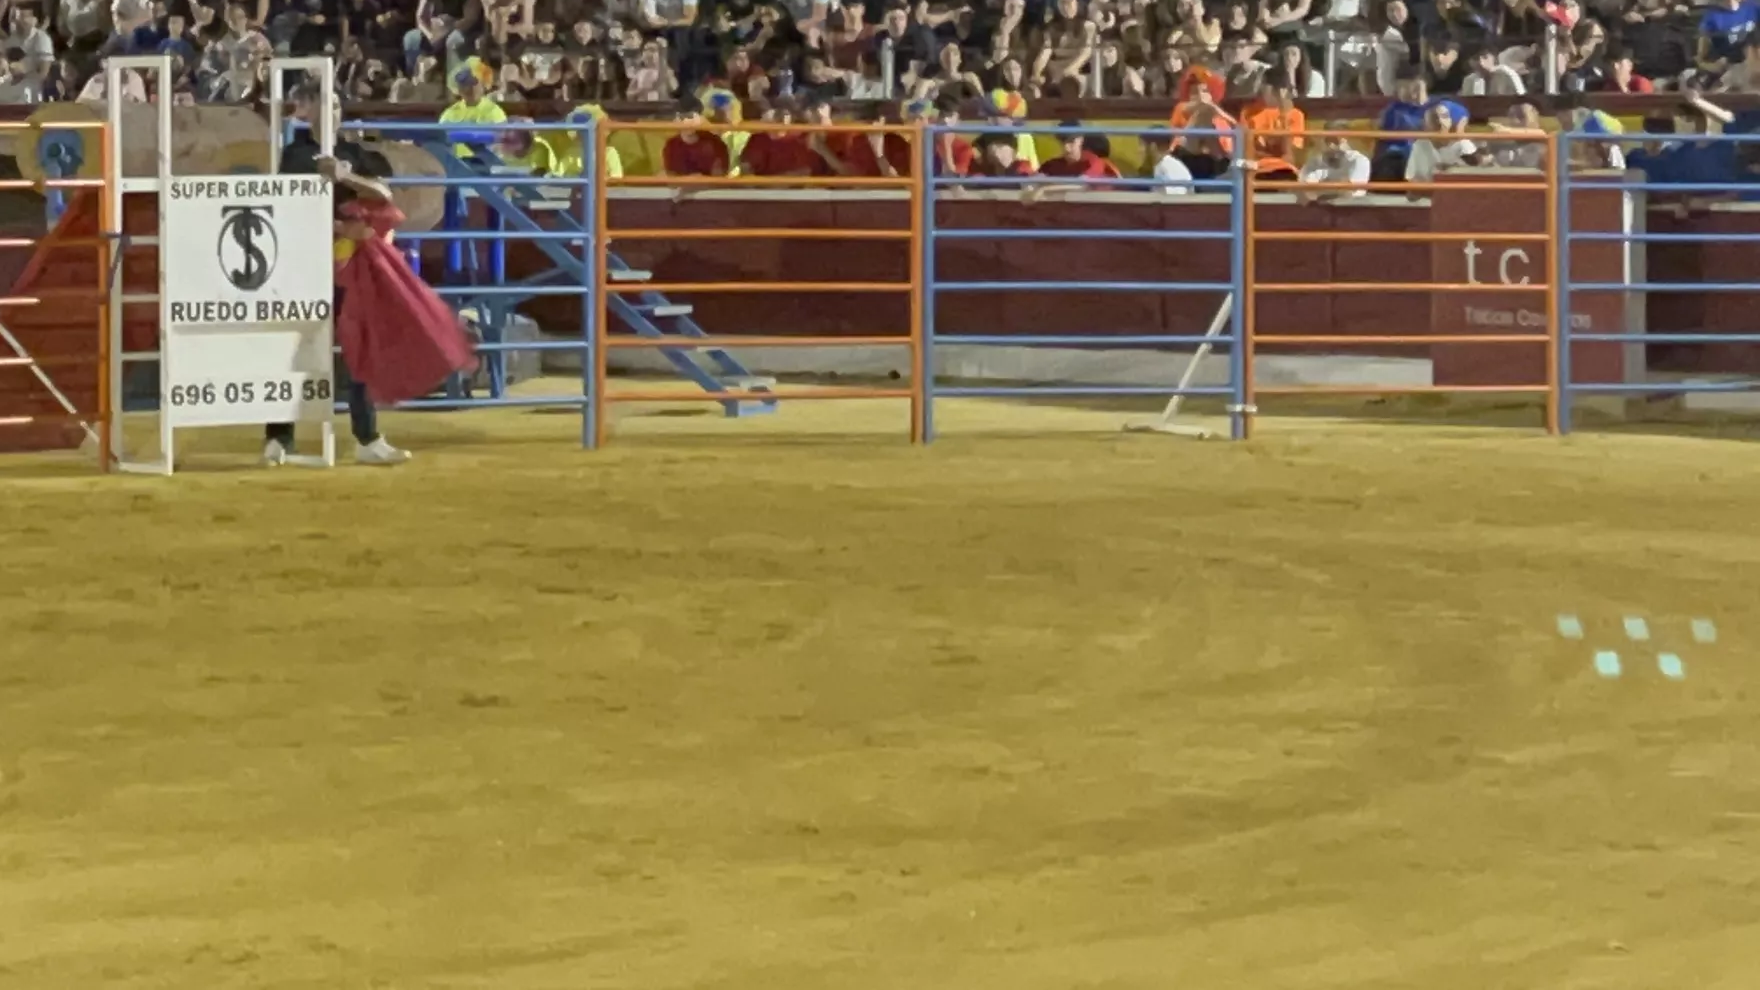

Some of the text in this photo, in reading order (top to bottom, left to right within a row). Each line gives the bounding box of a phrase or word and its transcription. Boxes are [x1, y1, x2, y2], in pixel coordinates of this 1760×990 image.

[171, 179, 329, 199] SUPER GRAN PRIX
[171, 299, 330, 322] RUEDO BRAVO
[171, 379, 330, 405] 696 05 28 58
